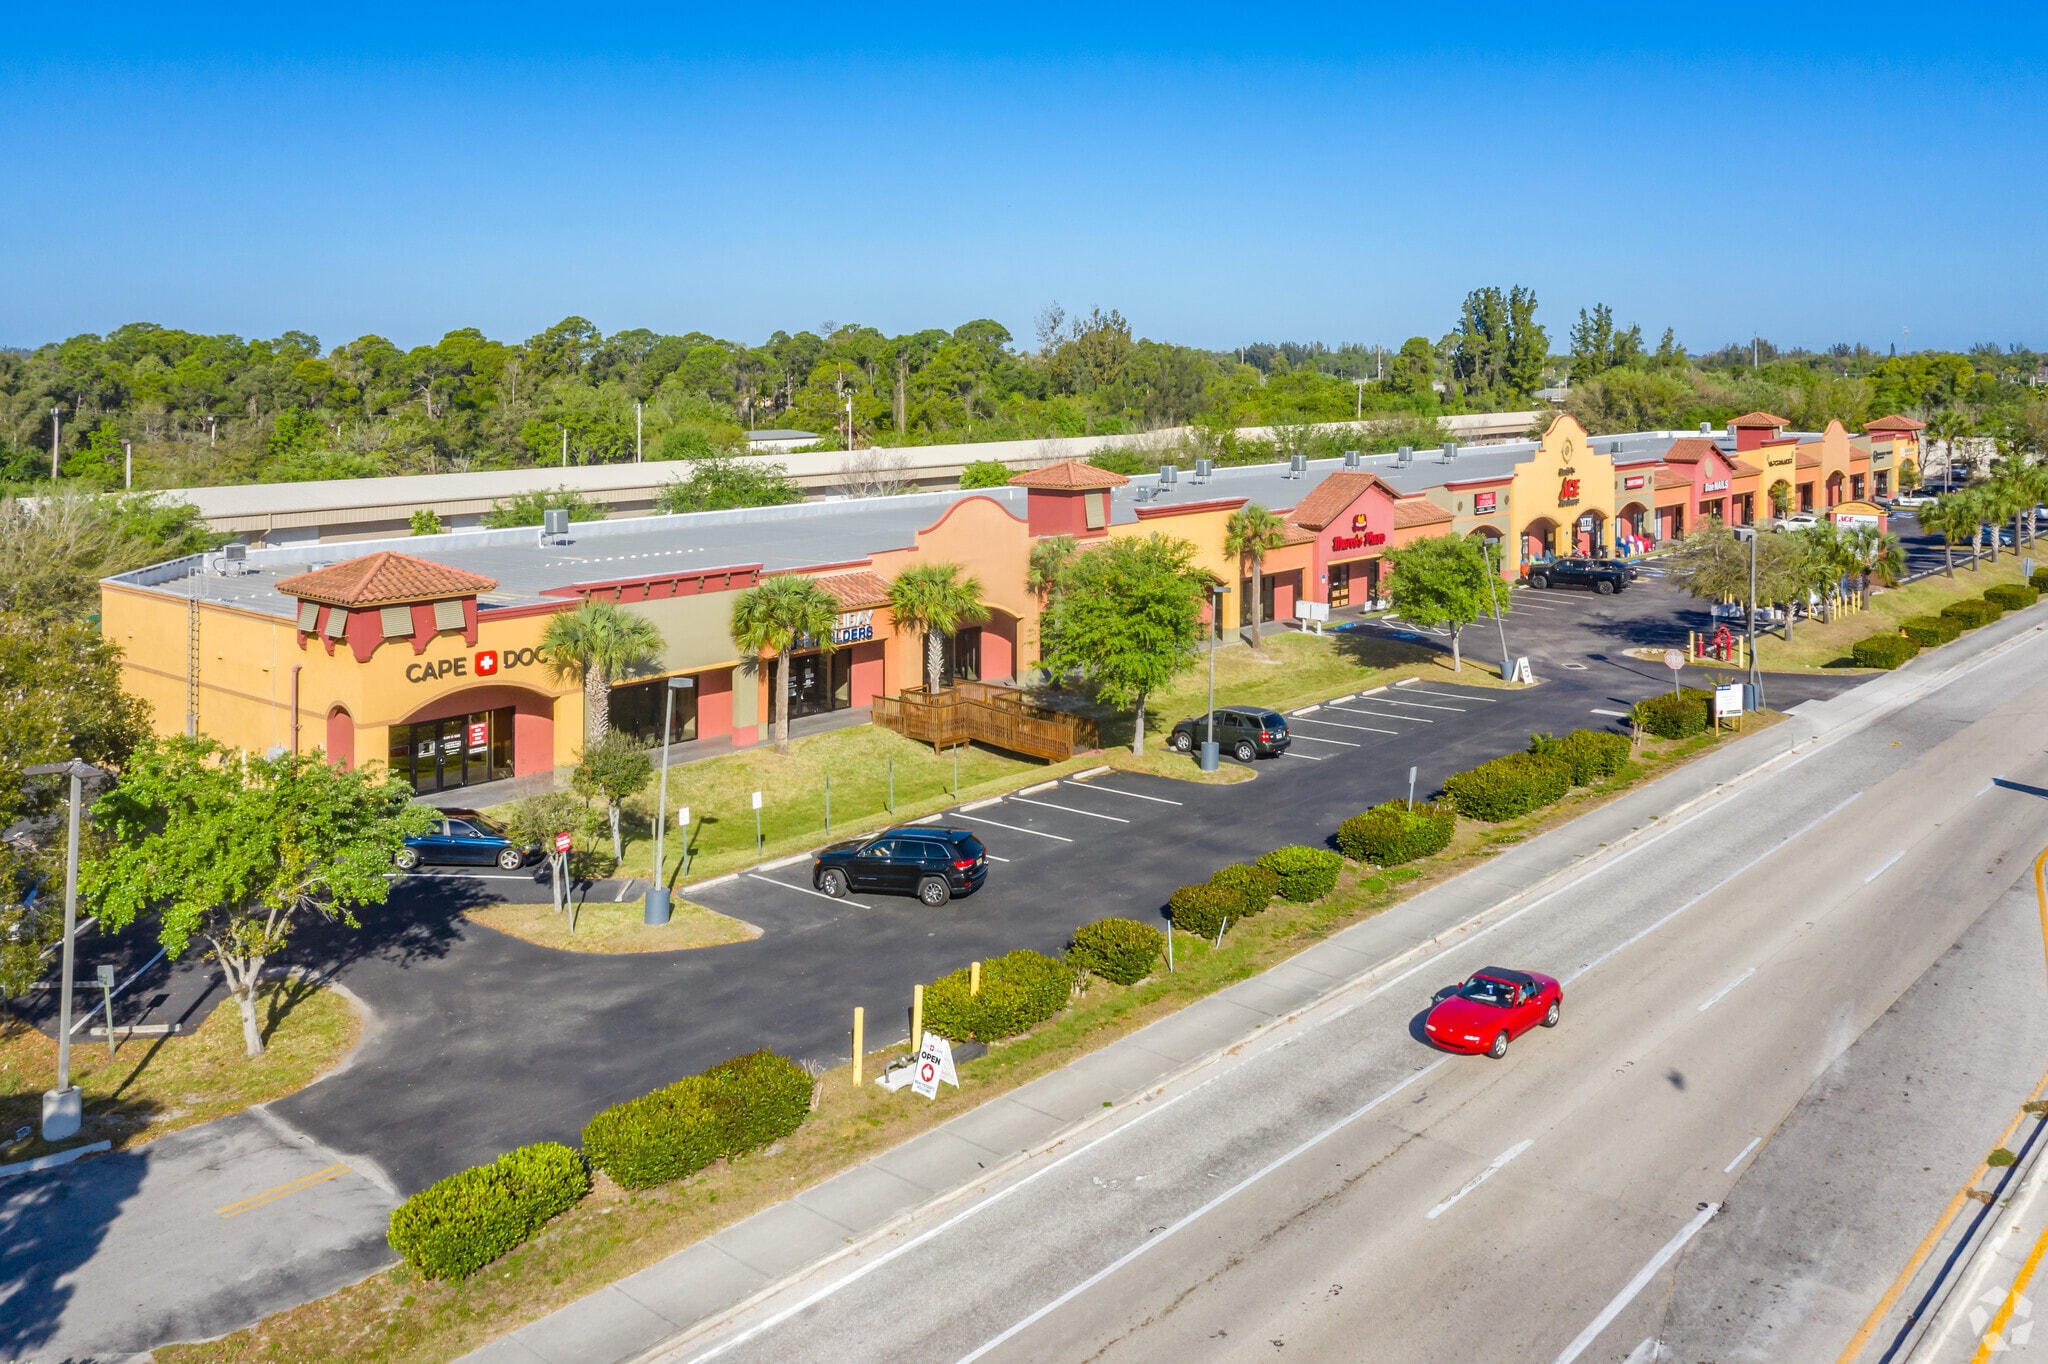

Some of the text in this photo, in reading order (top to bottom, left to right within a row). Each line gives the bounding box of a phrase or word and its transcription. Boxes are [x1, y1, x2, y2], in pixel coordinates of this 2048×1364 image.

[1561, 477, 1580, 499] ACE
[1839, 515, 1854, 523] ACE
[832, 609, 874, 630] LIDAY
[405, 656, 468, 683] CAPE
[921, 1051, 941, 1065] OPEN
